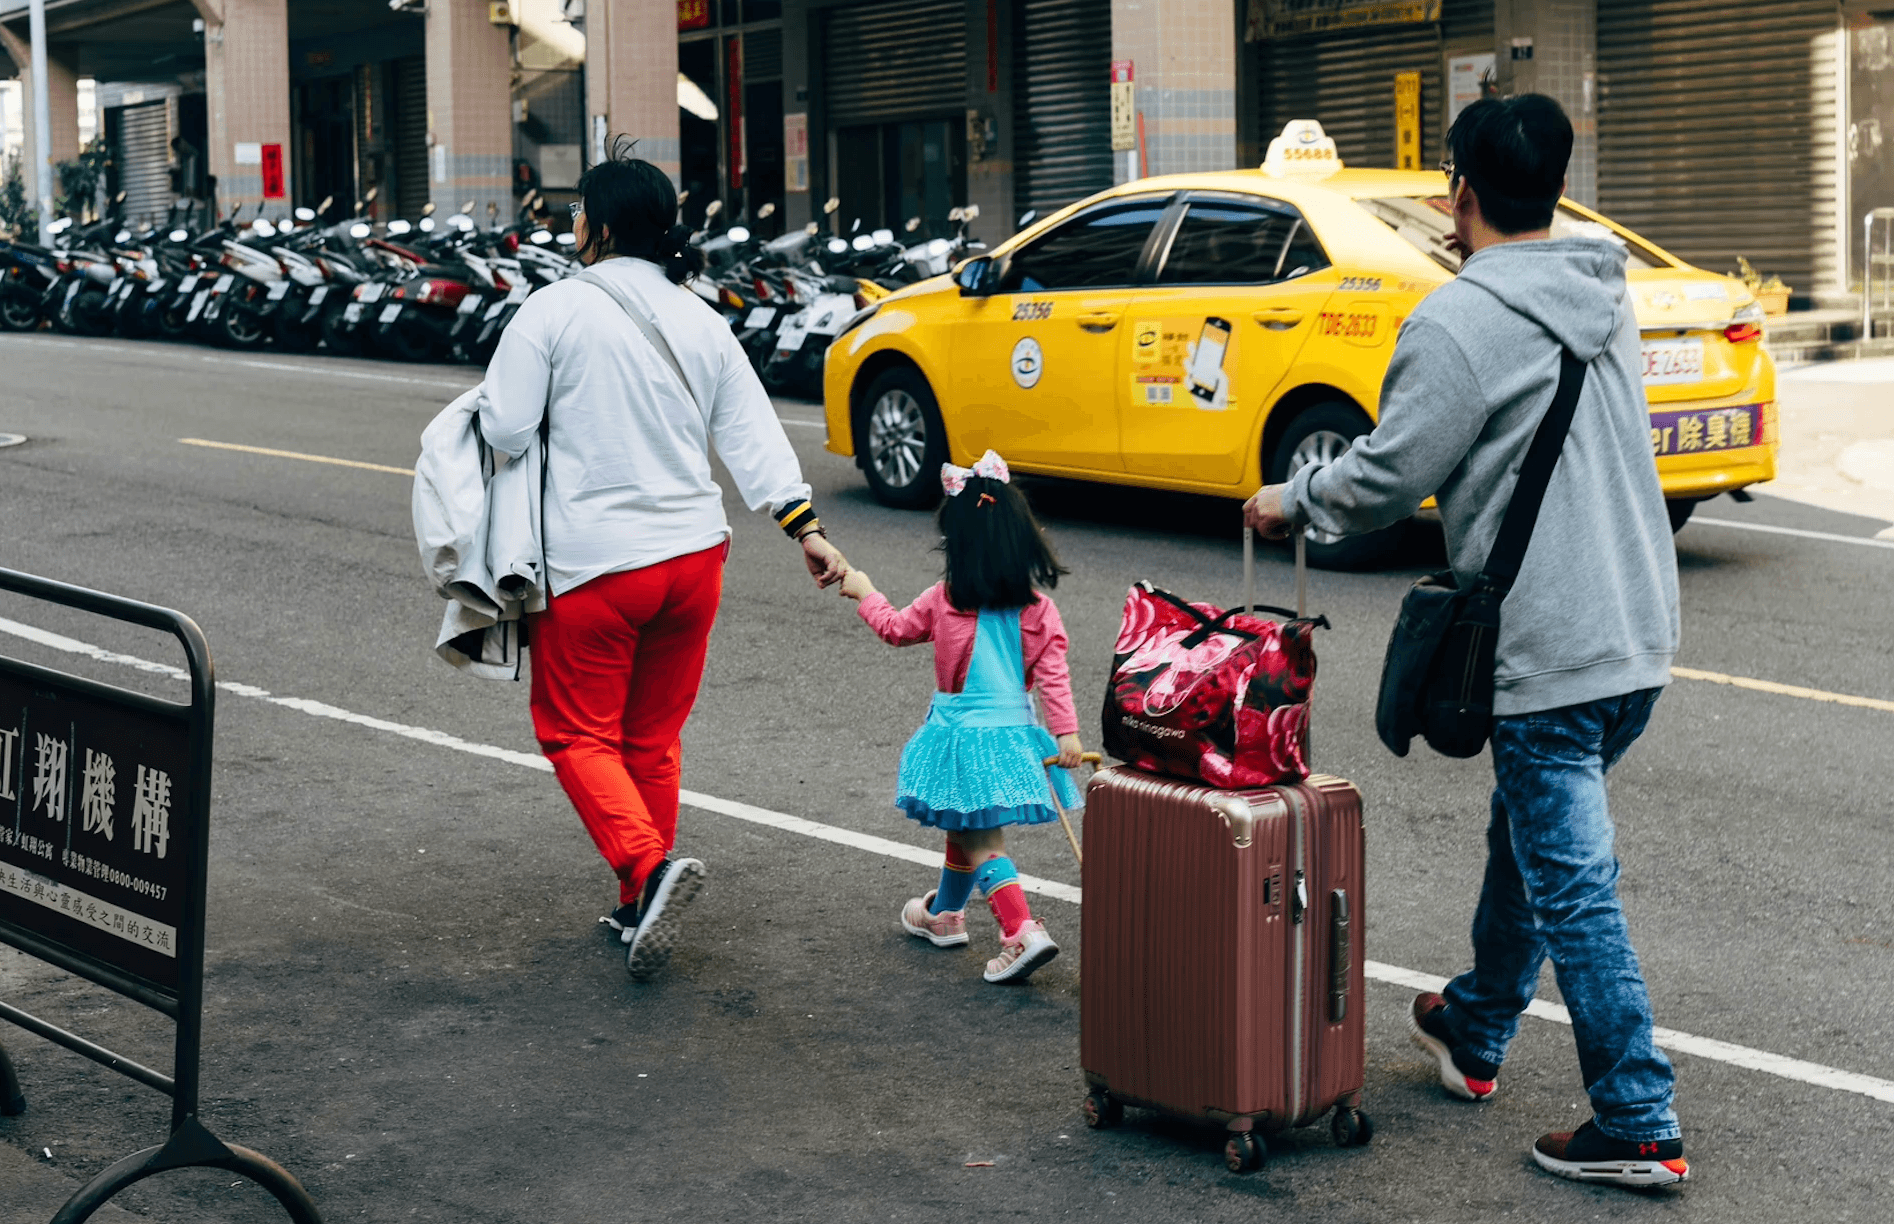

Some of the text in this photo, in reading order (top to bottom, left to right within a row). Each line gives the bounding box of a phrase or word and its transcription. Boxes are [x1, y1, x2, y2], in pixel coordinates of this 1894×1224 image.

[1284, 147, 1333, 160] 55688
[1338, 276, 1382, 291] 25356
[1012, 301, 1054, 321] 25356
